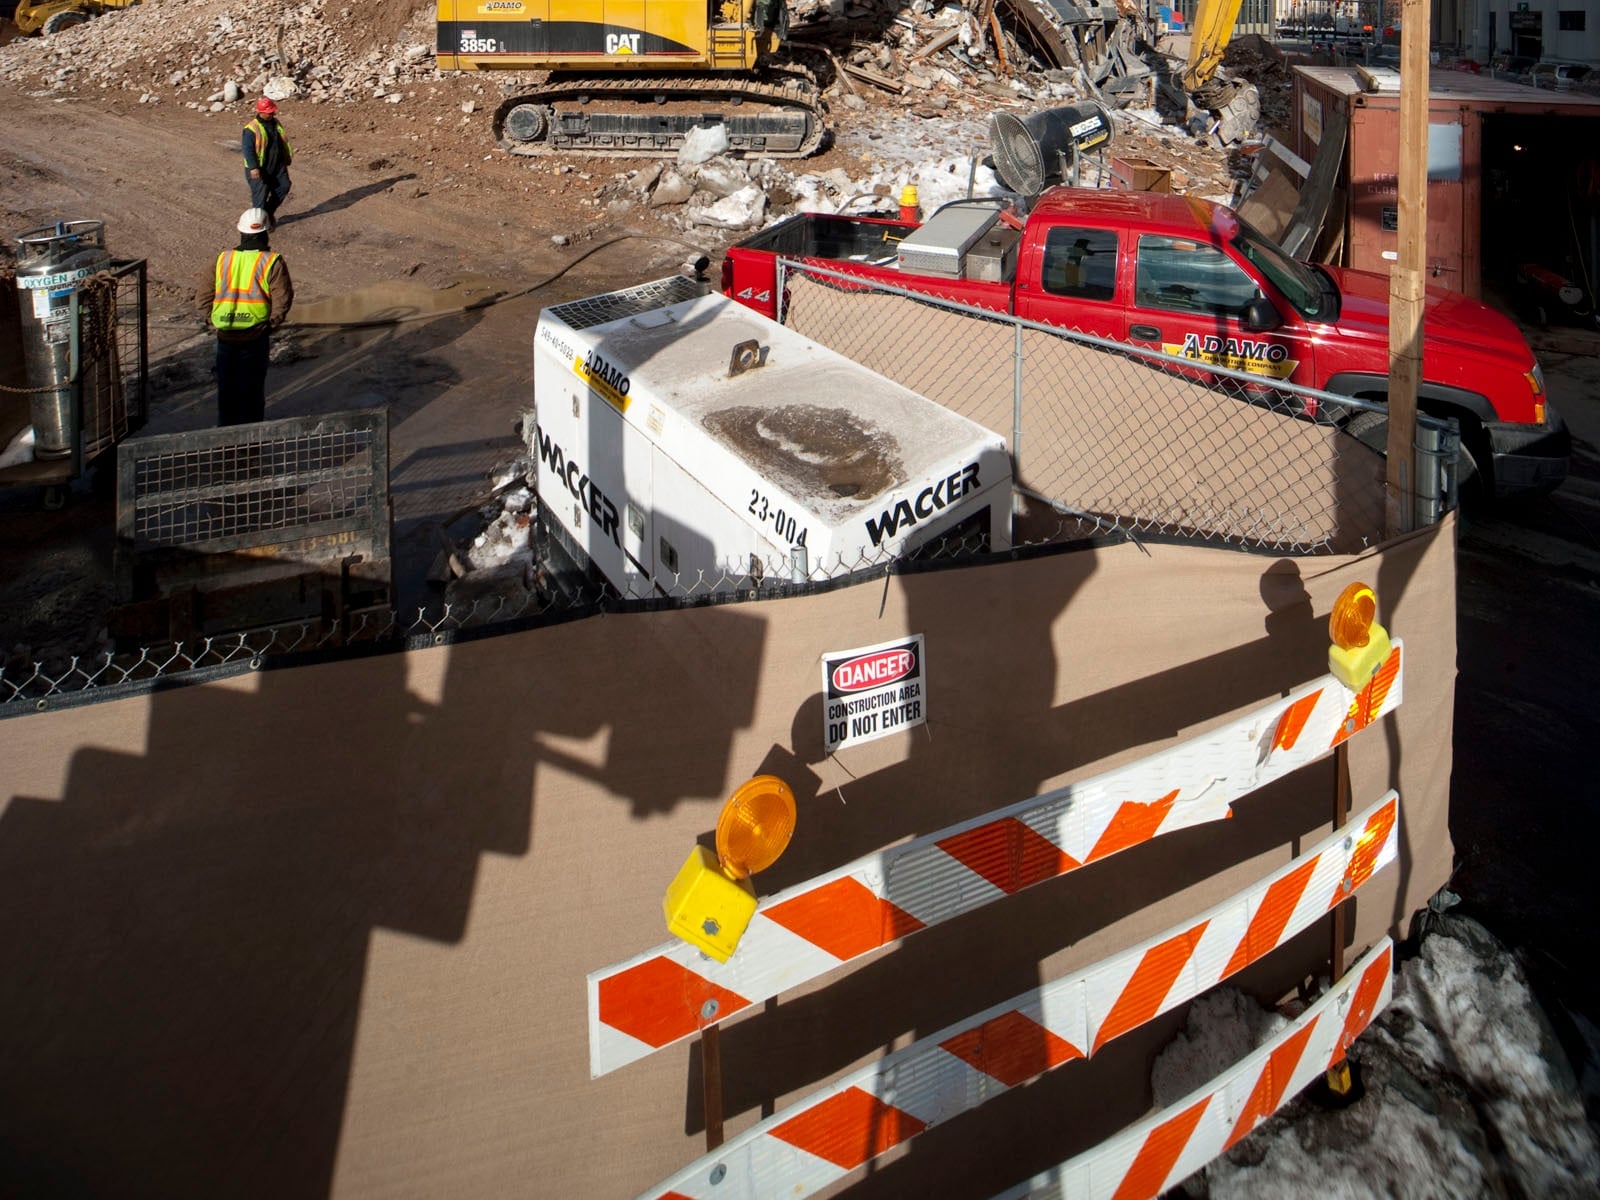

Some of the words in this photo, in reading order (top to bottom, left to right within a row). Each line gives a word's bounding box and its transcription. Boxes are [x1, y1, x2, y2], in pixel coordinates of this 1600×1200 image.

[486, 1, 522, 11] ADAMO
[460, 39, 496, 52] 385C
[606, 33, 641, 54] CAT
[1367, 184, 1397, 195] CLOS
[24, 274, 68, 287] OXYGEN
[1177, 333, 1288, 363] ADAMO
[579, 349, 631, 397] ADAMO
[537, 423, 621, 551] WACKER
[865, 462, 980, 547] WACKER
[748, 488, 808, 550] 23-004
[839, 652, 911, 688] DANGER
[828, 689, 897, 720] CONSTRUCTION
[899, 683, 921, 702] AREA
[829, 721, 848, 744] DO
[852, 713, 879, 738] NOT
[882, 700, 921, 730] ENTER
